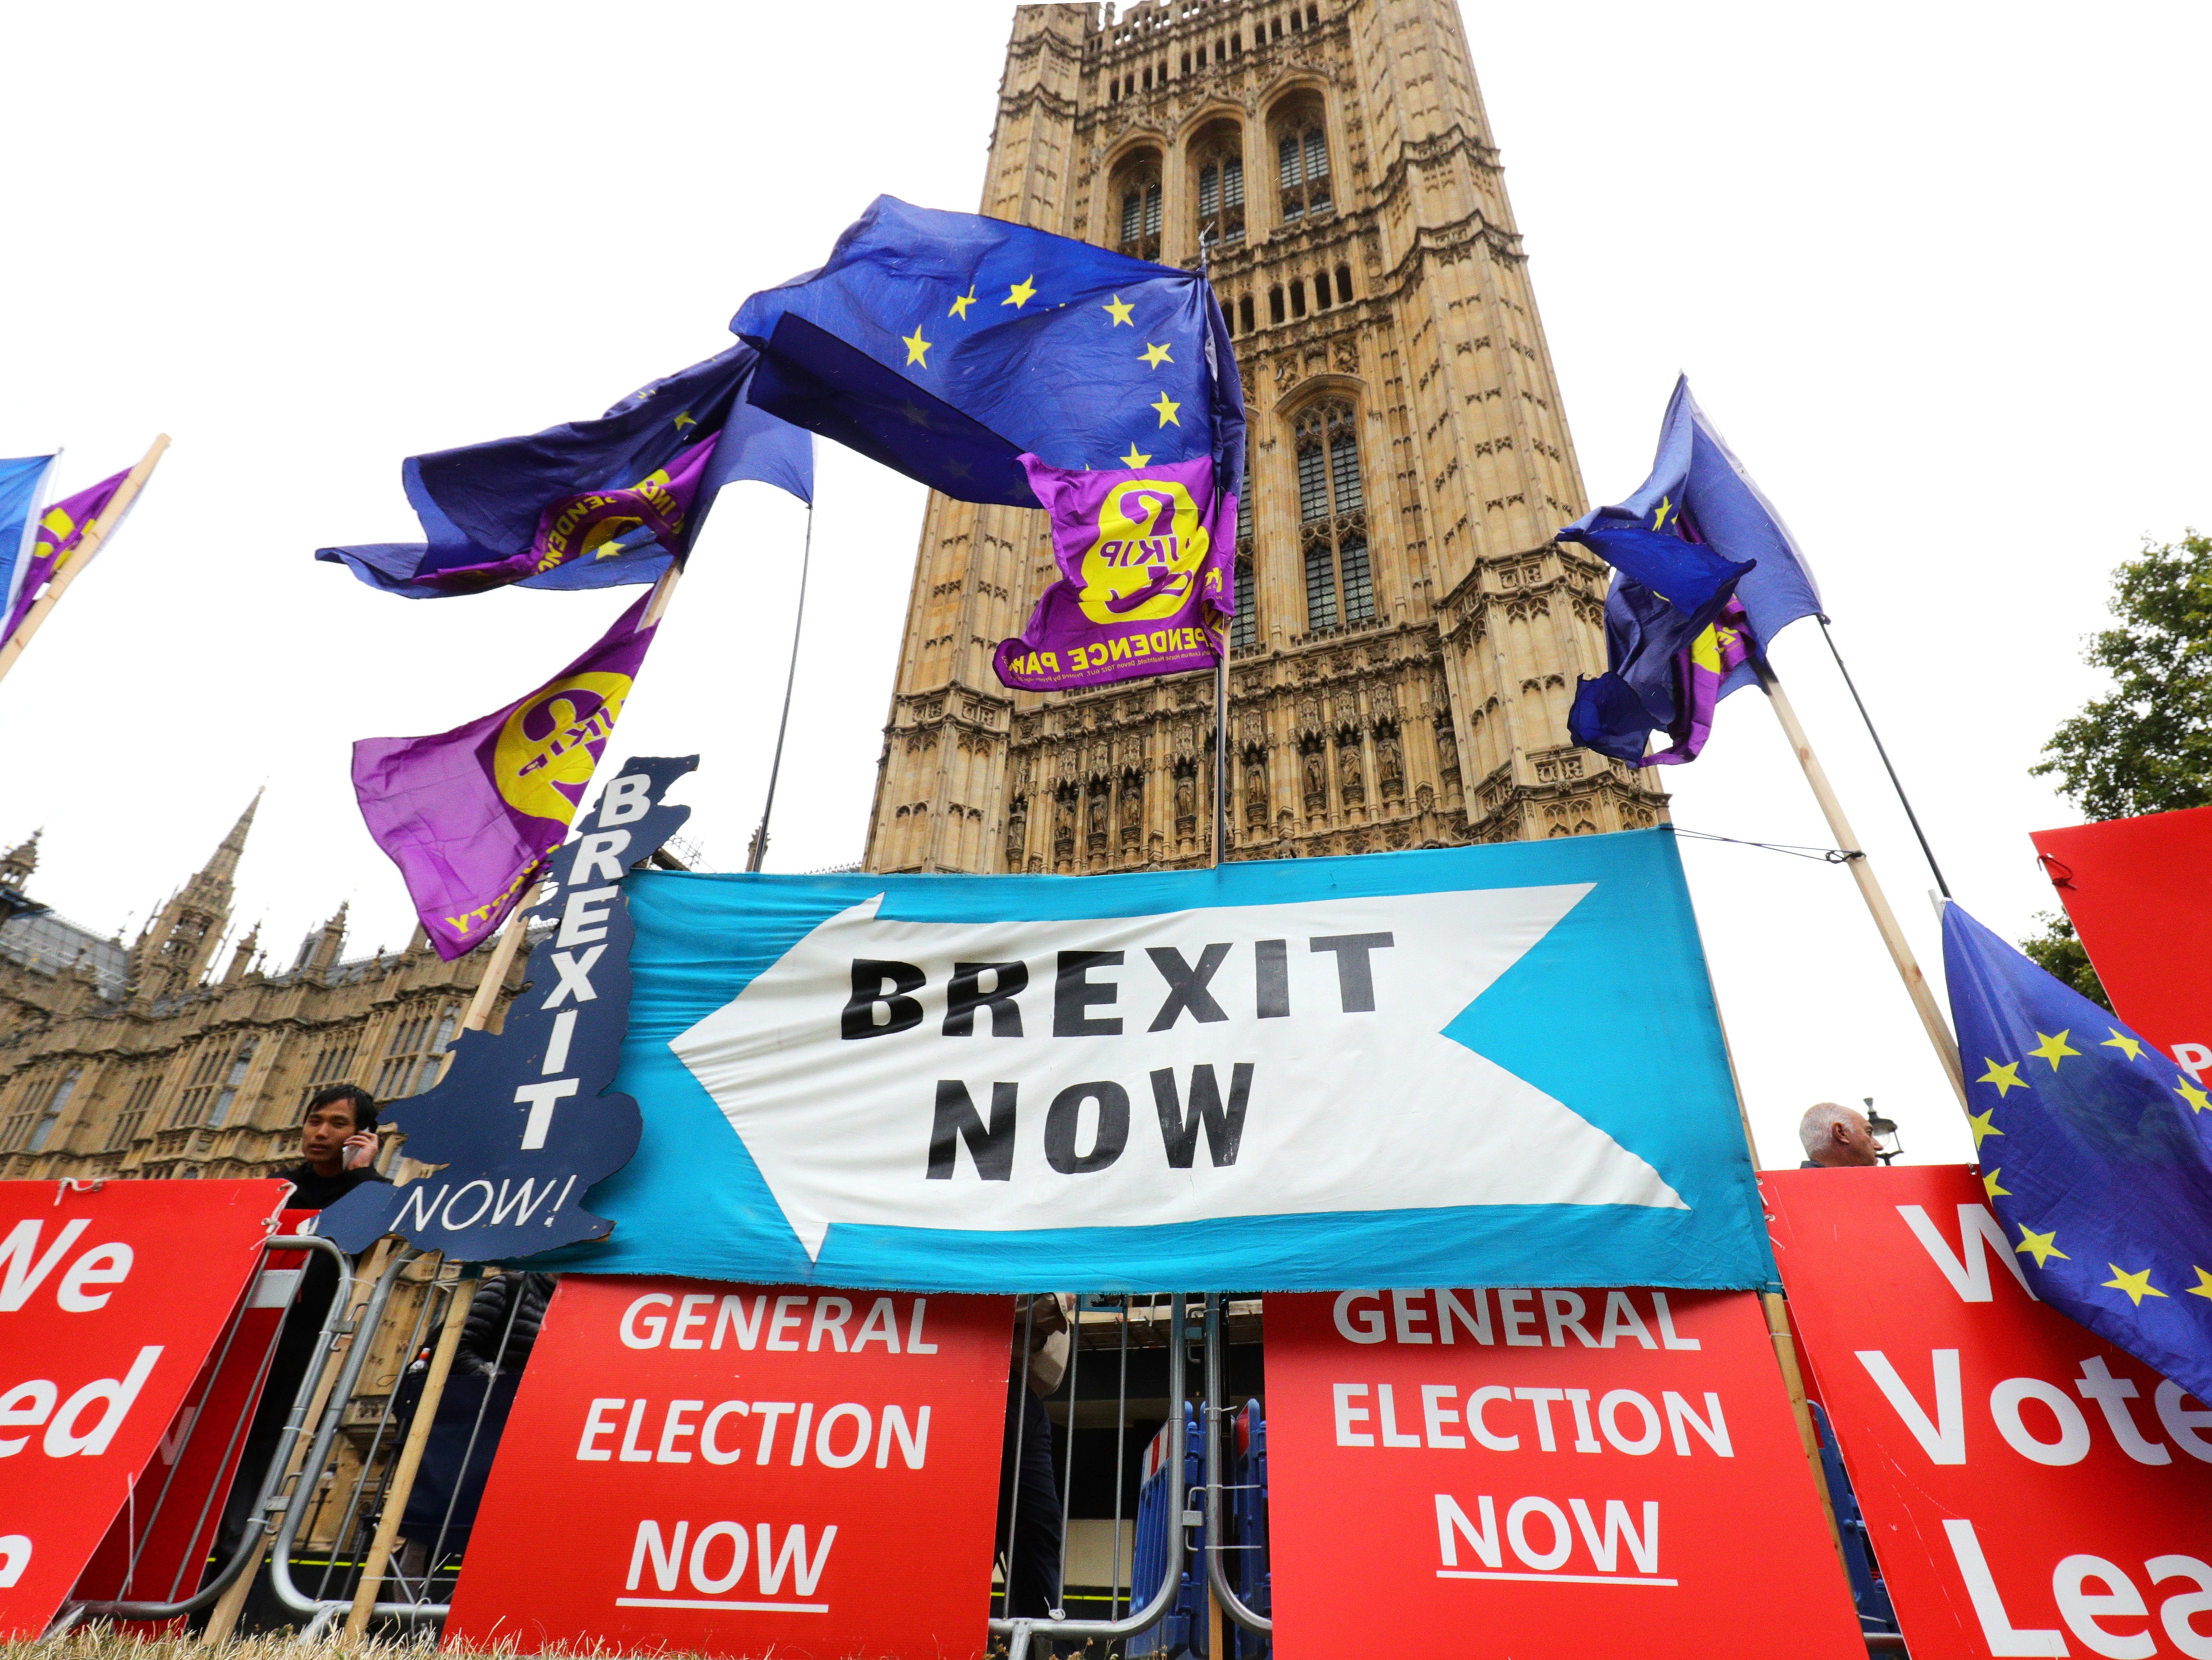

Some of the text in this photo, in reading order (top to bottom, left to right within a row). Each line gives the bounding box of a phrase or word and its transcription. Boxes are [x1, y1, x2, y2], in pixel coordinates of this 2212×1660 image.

[514, 774, 651, 1150] BREXIT
[841, 930, 1394, 1040] BREXIT
[927, 1064, 1253, 1181] NOW
[389, 1174, 577, 1231] NOW!
[620, 1293, 938, 1354] GENERAL
[1334, 1288, 1701, 1351] GENERAL
[576, 1398, 931, 1469] ELECTION
[1333, 1383, 1734, 1457] ELECTION
[626, 1520, 838, 1596] NOW
[1435, 1494, 1659, 1573] NOW
[1943, 1519, 2212, 1660] Lea
